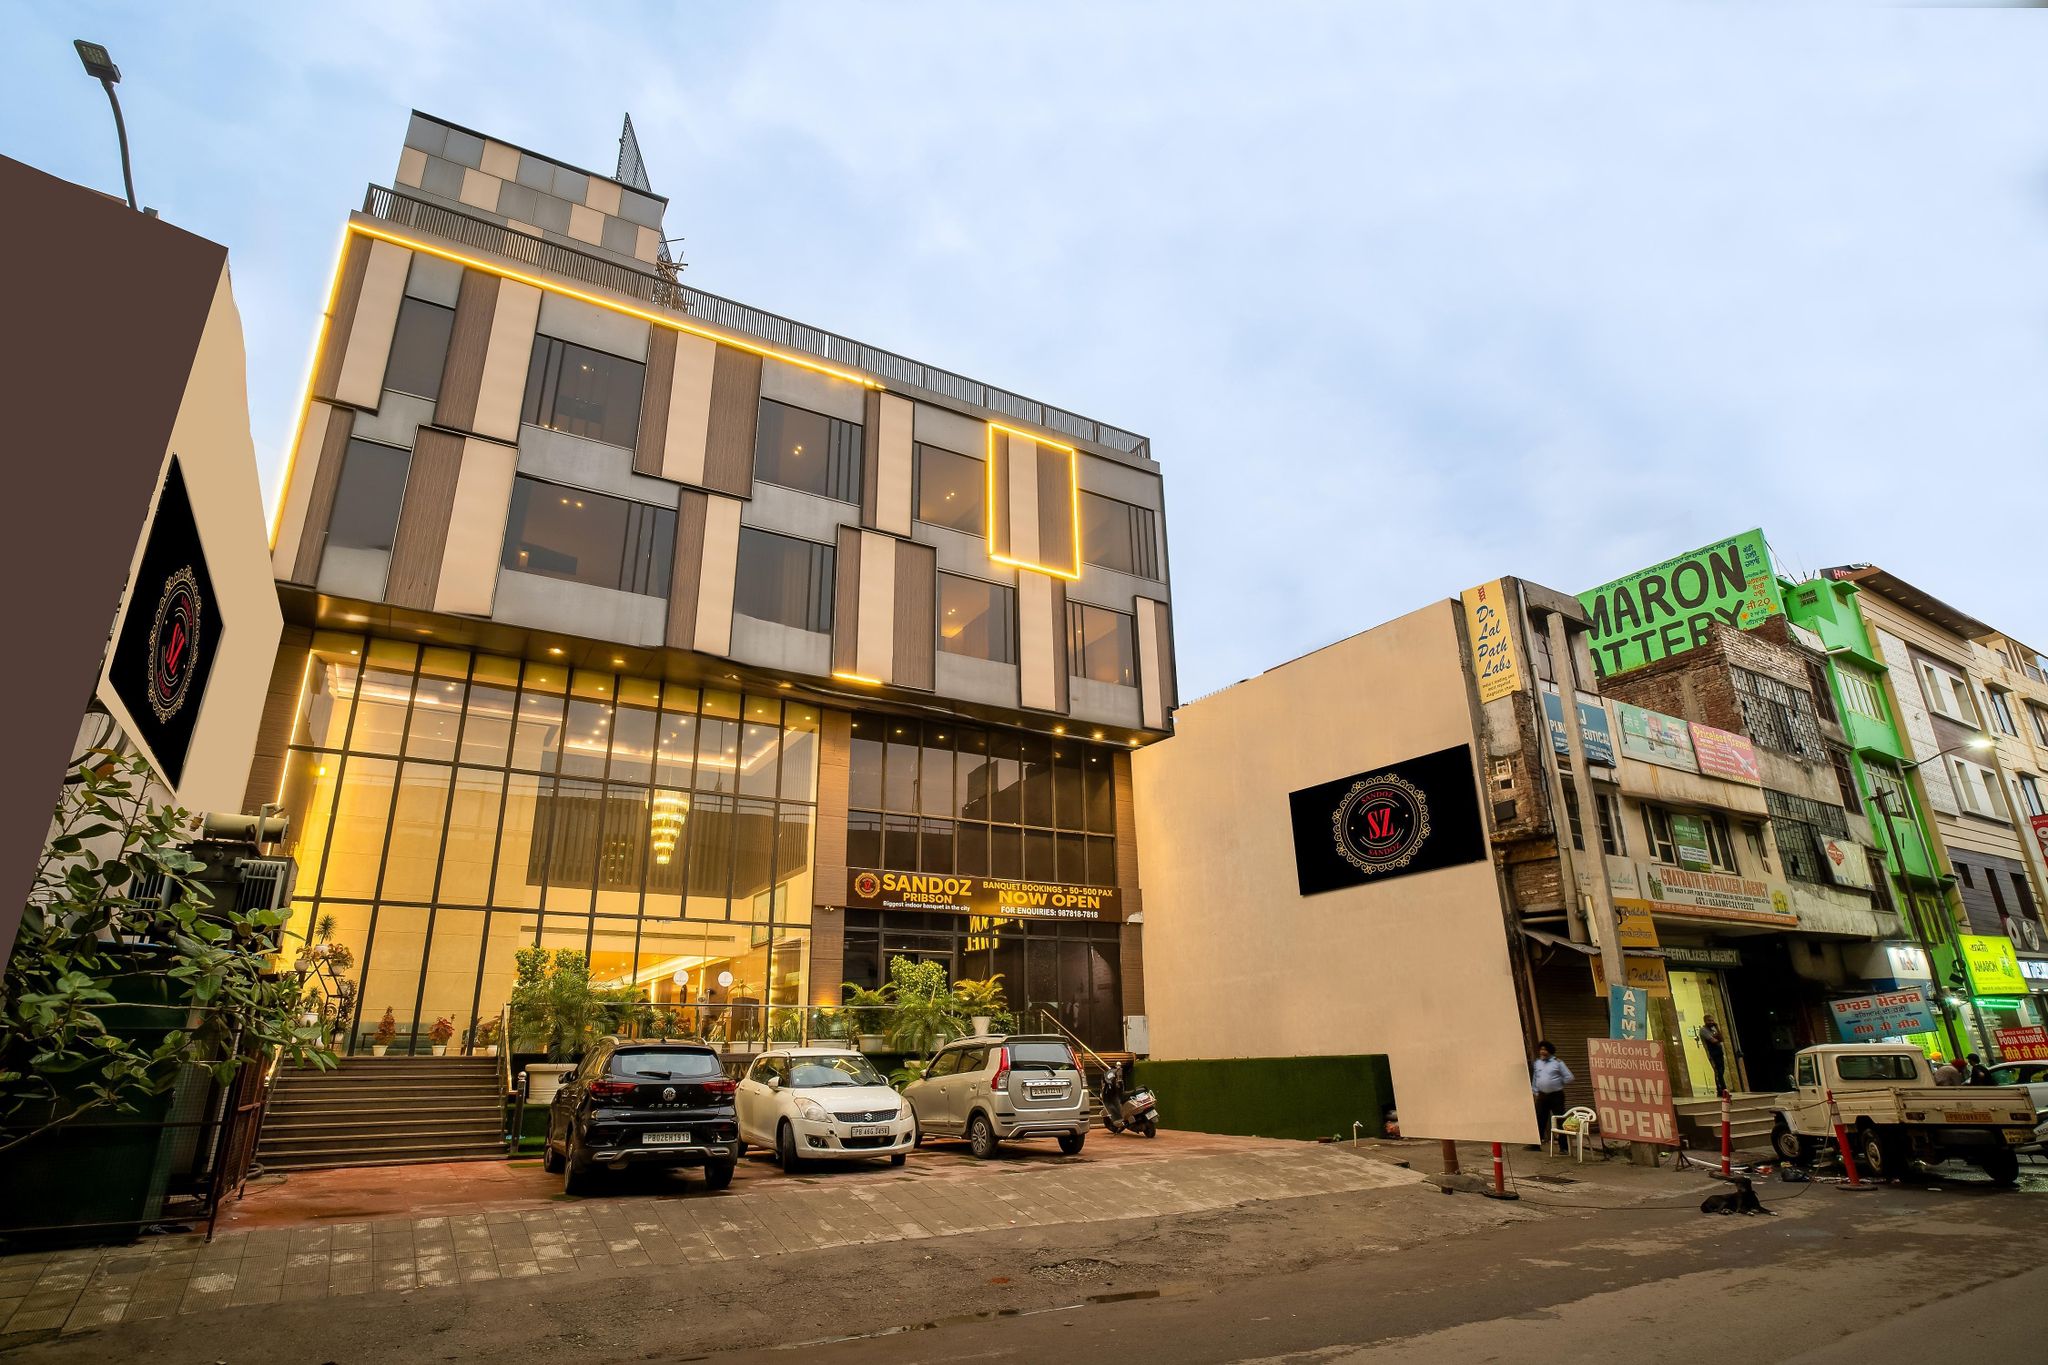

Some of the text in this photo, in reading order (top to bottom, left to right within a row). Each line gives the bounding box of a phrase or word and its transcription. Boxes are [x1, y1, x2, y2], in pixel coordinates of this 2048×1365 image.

[1477, 605, 1495, 623] Dr
[1478, 619, 1500, 641] Lal
[1478, 636, 1508, 662] Path
[1482, 655, 1511, 679] Labs
[1361, 791, 1394, 804] SANDOZ
[1367, 807, 1394, 840] SZ
[1367, 842, 1402, 856] SANDOZ
[883, 873, 972, 896] SANDOZ
[983, 881, 1020, 891] BANQUET
[1022, 884, 1062, 893] BOOKINGS
[1069, 887, 1097, 896] 50-500
[1098, 888, 1112, 897] PAX
[1701, 874, 1743, 895] FERTILIZER
[1743, 880, 1769, 898] AGENCY
[883, 900, 904, 908] Biggest
[905, 901, 922, 909] indoor
[951, 903, 960, 911] the
[961, 904, 970, 912] city
[904, 892, 952, 904] PRIBSON
[999, 891, 1100, 909] NOW OPEN
[1001, 906, 1016, 914] FOR
[1017, 907, 1057, 917] ENQUIRIES:
[1999, 1034, 2045, 1046] POOJA TRADERS
[1590, 1057, 1665, 1072] THE PRIBSON HOTEL
[1597, 1074, 1664, 1106] NOW
[1600, 1106, 1673, 1139] OPEN
